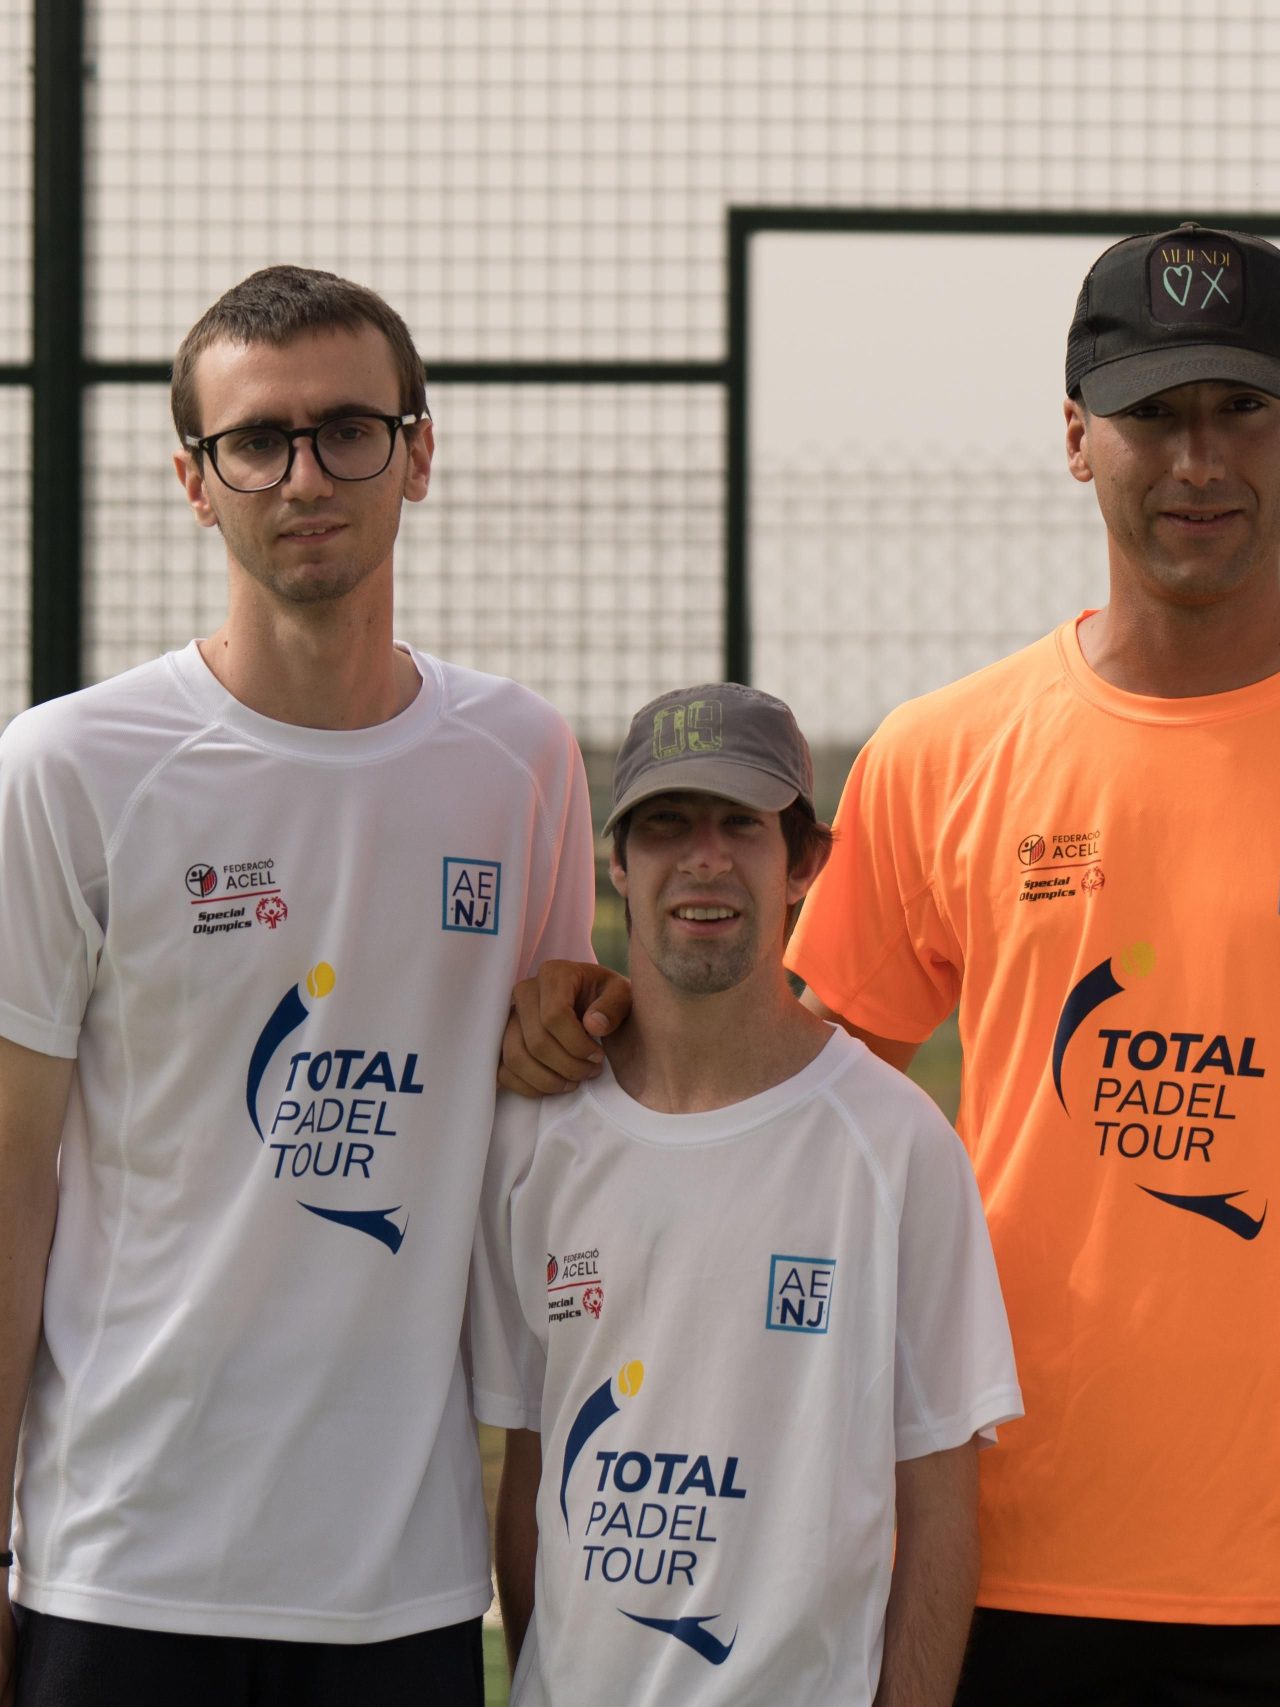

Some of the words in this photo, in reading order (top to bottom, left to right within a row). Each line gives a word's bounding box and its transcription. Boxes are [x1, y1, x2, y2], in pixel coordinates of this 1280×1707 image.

[1052, 830, 1100, 843] FEDERACIÓ
[1052, 842, 1098, 859] ACELL
[223, 858, 275, 873] FEDERACIÓ
[226, 871, 276, 890] ACELL
[452, 869, 494, 899] AE
[1019, 889, 1076, 901] Olympics
[1024, 877, 1071, 890] Special
[193, 920, 252, 935] Olympics
[198, 907, 245, 922] Special
[1098, 1029, 1266, 1078] TOTAL
[285, 1049, 424, 1094] TOTAL
[1094, 1078, 1237, 1120] PADEL
[271, 1098, 397, 1136] PADEL
[1094, 1121, 1215, 1163] TOUR
[270, 1141, 375, 1179] TOUR
[562, 1261, 598, 1279] ACELL
[563, 1248, 599, 1264] FEDERACIÓ
[779, 1267, 831, 1299] AE
[595, 1451, 747, 1499] TOTAL
[585, 1501, 717, 1542] PADEL
[582, 1545, 698, 1586] TOUR
